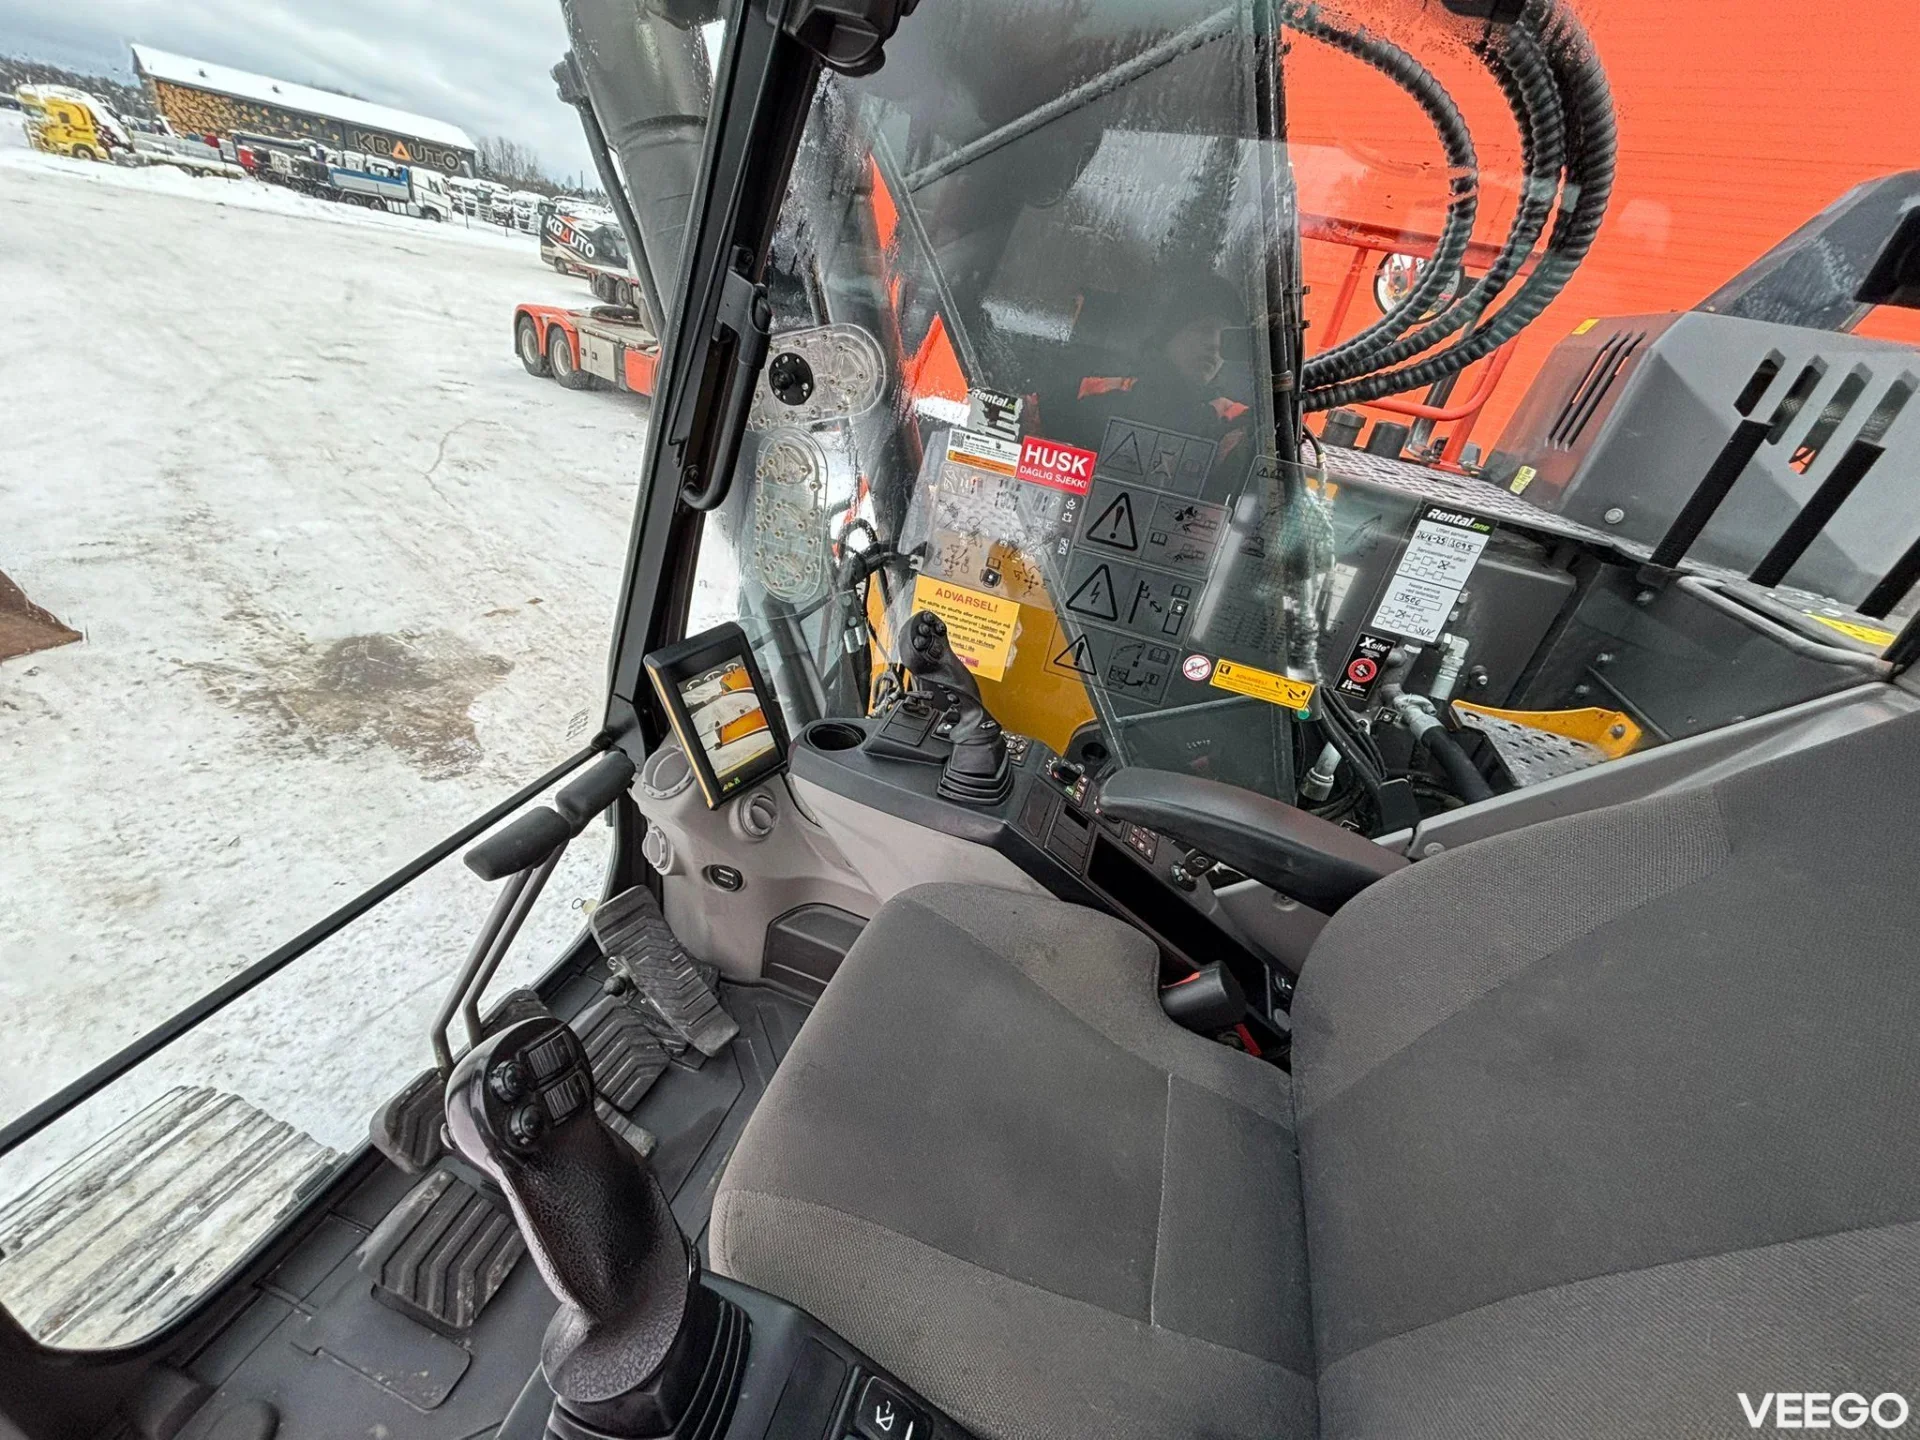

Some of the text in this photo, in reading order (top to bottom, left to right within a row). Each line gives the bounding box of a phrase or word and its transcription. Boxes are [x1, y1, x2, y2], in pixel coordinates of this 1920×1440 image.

[354, 131, 460, 171] KBAUTO
[546, 215, 595, 258] KBAUTO
[1020, 465, 1053, 481] DAGLIG
[1024, 444, 1089, 477] HUSK
[1427, 508, 1490, 532] Rental.one
[935, 587, 999, 613] ADVARSEL!
